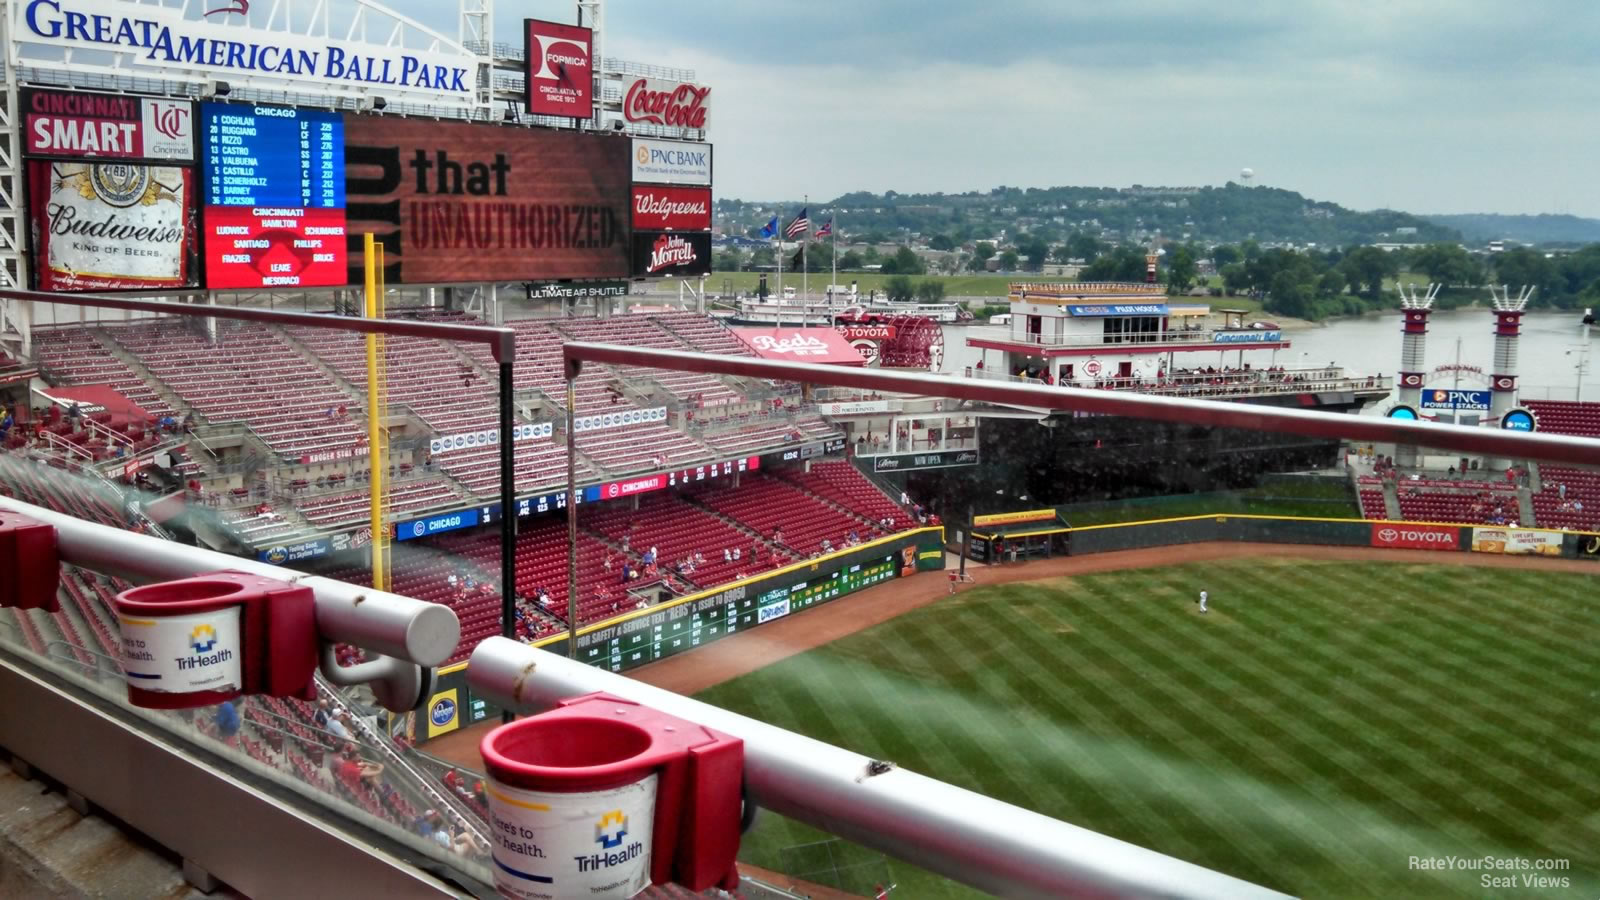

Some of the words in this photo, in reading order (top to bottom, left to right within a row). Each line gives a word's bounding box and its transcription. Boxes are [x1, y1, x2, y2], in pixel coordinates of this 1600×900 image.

[547, 53, 586, 67] FORMICA
[323, 46, 397, 85] BALL
[398, 55, 470, 93] PARK
[546, 94, 564, 102] SINCE
[32, 92, 137, 118] CINCINNATI
[254, 106, 297, 118] CHICAGO
[212, 115, 218, 124] 8
[221, 115, 255, 126] COGHLAN
[300, 121, 309, 130] LF
[34, 117, 137, 153] SMART
[209, 125, 219, 134] 20
[221, 125, 257, 136] RUGGIANO
[209, 135, 219, 144] 44
[221, 135, 243, 145] RIZZO
[210, 145, 219, 154] 13
[222, 146, 249, 156] CASTRO
[300, 150, 310, 159] SS
[651, 149, 675, 165] PNC
[677, 151, 706, 167] BANK
[210, 156, 219, 165] 24
[222, 156, 258, 167] VALBUENA
[214, 166, 220, 175] 5
[222, 166, 255, 176] CASTILLO
[303, 169, 309, 178] C
[409, 149, 512, 197] that
[212, 176, 220, 185] 19
[223, 176, 268, 187] SCHIERHOLTZ
[212, 186, 220, 195] 15
[223, 186, 251, 195] BARNEY
[223, 197, 256, 206] JACKSON
[303, 198, 310, 207] P
[635, 194, 707, 221] Walgreens
[252, 208, 304, 217] CINCINNATI
[48, 203, 184, 243] Budweiser
[261, 219, 297, 228] HAMILTON
[216, 226, 249, 235] LUDWICK
[233, 239, 270, 249] SANTIAGO
[293, 239, 323, 248] PHILLIPS
[665, 234, 685, 250] John
[73, 242, 100, 254] KING
[105, 246, 120, 256] OF
[222, 254, 251, 263] FRAZIER
[313, 253, 335, 262] BRUCE
[646, 242, 697, 273] Morrell
[270, 263, 291, 272] LEAKE
[262, 276, 300, 285] MESORACO
[530, 288, 572, 299] ULTIMATE
[573, 288, 587, 297] AIR
[588, 286, 625, 297] SHUTTLE
[1135, 305, 1161, 313] HOUSE
[849, 327, 890, 337] TOYOTA
[1214, 332, 1262, 343] Cincinnati
[752, 333, 829, 353] Reds
[1448, 391, 1481, 404] PNC
[1424, 401, 1455, 409] POWER
[1456, 402, 1488, 410] STACKS
[914, 456, 926, 465] NOW
[927, 455, 941, 464] OPEN
[622, 478, 658, 492] CINCINNATI
[429, 516, 460, 531] CHICAGO
[1400, 531, 1453, 543] TOYOTA
[288, 545, 305, 553] Feeling
[577, 635, 591, 648] FOR
[591, 628, 616, 644] SAFETY
[616, 626, 622, 636] &
[623, 616, 650, 634] SERVICE
[651, 611, 665, 625] TEXT
[692, 604, 697, 612] &
[698, 598, 715, 611] ISSUE
[715, 594, 722, 605] TO
[136, 639, 146, 648] to
[175, 649, 233, 671] TriHealth
[434, 703, 455, 721] Kroger
[520, 827, 534, 840] to
[503, 837, 547, 859] health.
[574, 842, 643, 873] TriHealth
